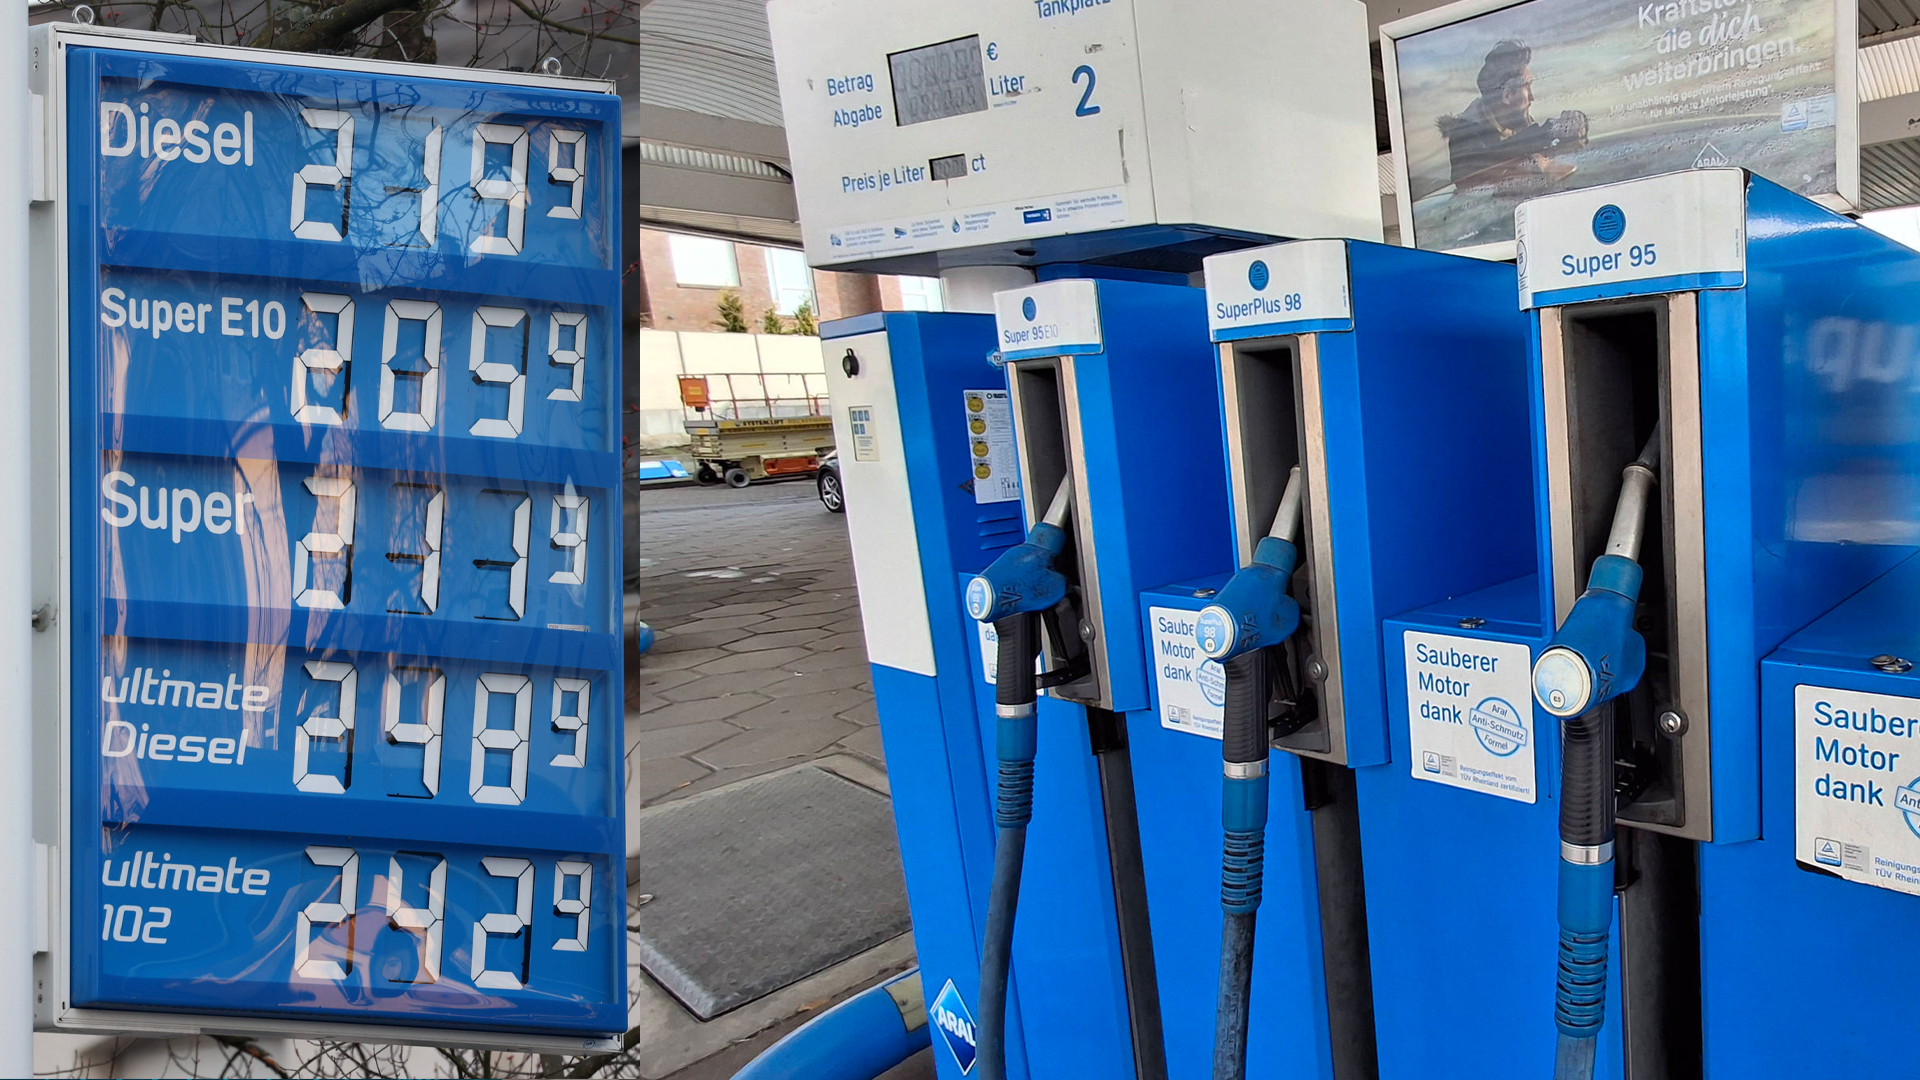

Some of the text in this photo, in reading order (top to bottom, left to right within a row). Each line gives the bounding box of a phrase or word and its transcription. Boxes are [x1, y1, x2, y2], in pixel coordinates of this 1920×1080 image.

[1657, 3, 1762, 55] die dich
[986, 42, 998, 61] €
[827, 74, 1025, 97] Betrag Liter
[1071, 65, 1101, 118] 2
[834, 104, 882, 128] Abgabe
[100, 101, 254, 167] Diesel
[842, 171, 876, 193] Preis
[879, 171, 891, 192] je
[894, 165, 925, 184] Liter
[971, 154, 986, 172] ct
[1561, 243, 1657, 278] Super 95
[101, 287, 213, 340] Super
[221, 296, 286, 340] E10
[1216, 293, 1302, 321] SuperPlus 98
[1003, 329, 1029, 345] Super
[101, 471, 255, 544] Super
[1203, 626, 1216, 638] 98
[1161, 639, 1196, 659] Motor
[1416, 643, 1498, 673] Sauberer
[1164, 663, 1193, 682] dank
[1418, 671, 1470, 698] Motor
[101, 667, 270, 712] ultimate
[1420, 700, 1463, 725] dank
[1491, 704, 1508, 717] Aral
[1814, 701, 1920, 739] Sauber
[1472, 713, 1524, 741] Anti-Schmutz
[1484, 734, 1508, 750] Formel
[101, 720, 249, 766] Diesel
[1815, 736, 1900, 773] Motor
[1460, 773, 1471, 781] TÜV
[1814, 773, 1885, 807] dank
[101, 850, 271, 896] ultimate
[1875, 867, 1893, 879] TÜV
[101, 903, 172, 945] 102
[937, 1005, 976, 1047] ARAL
